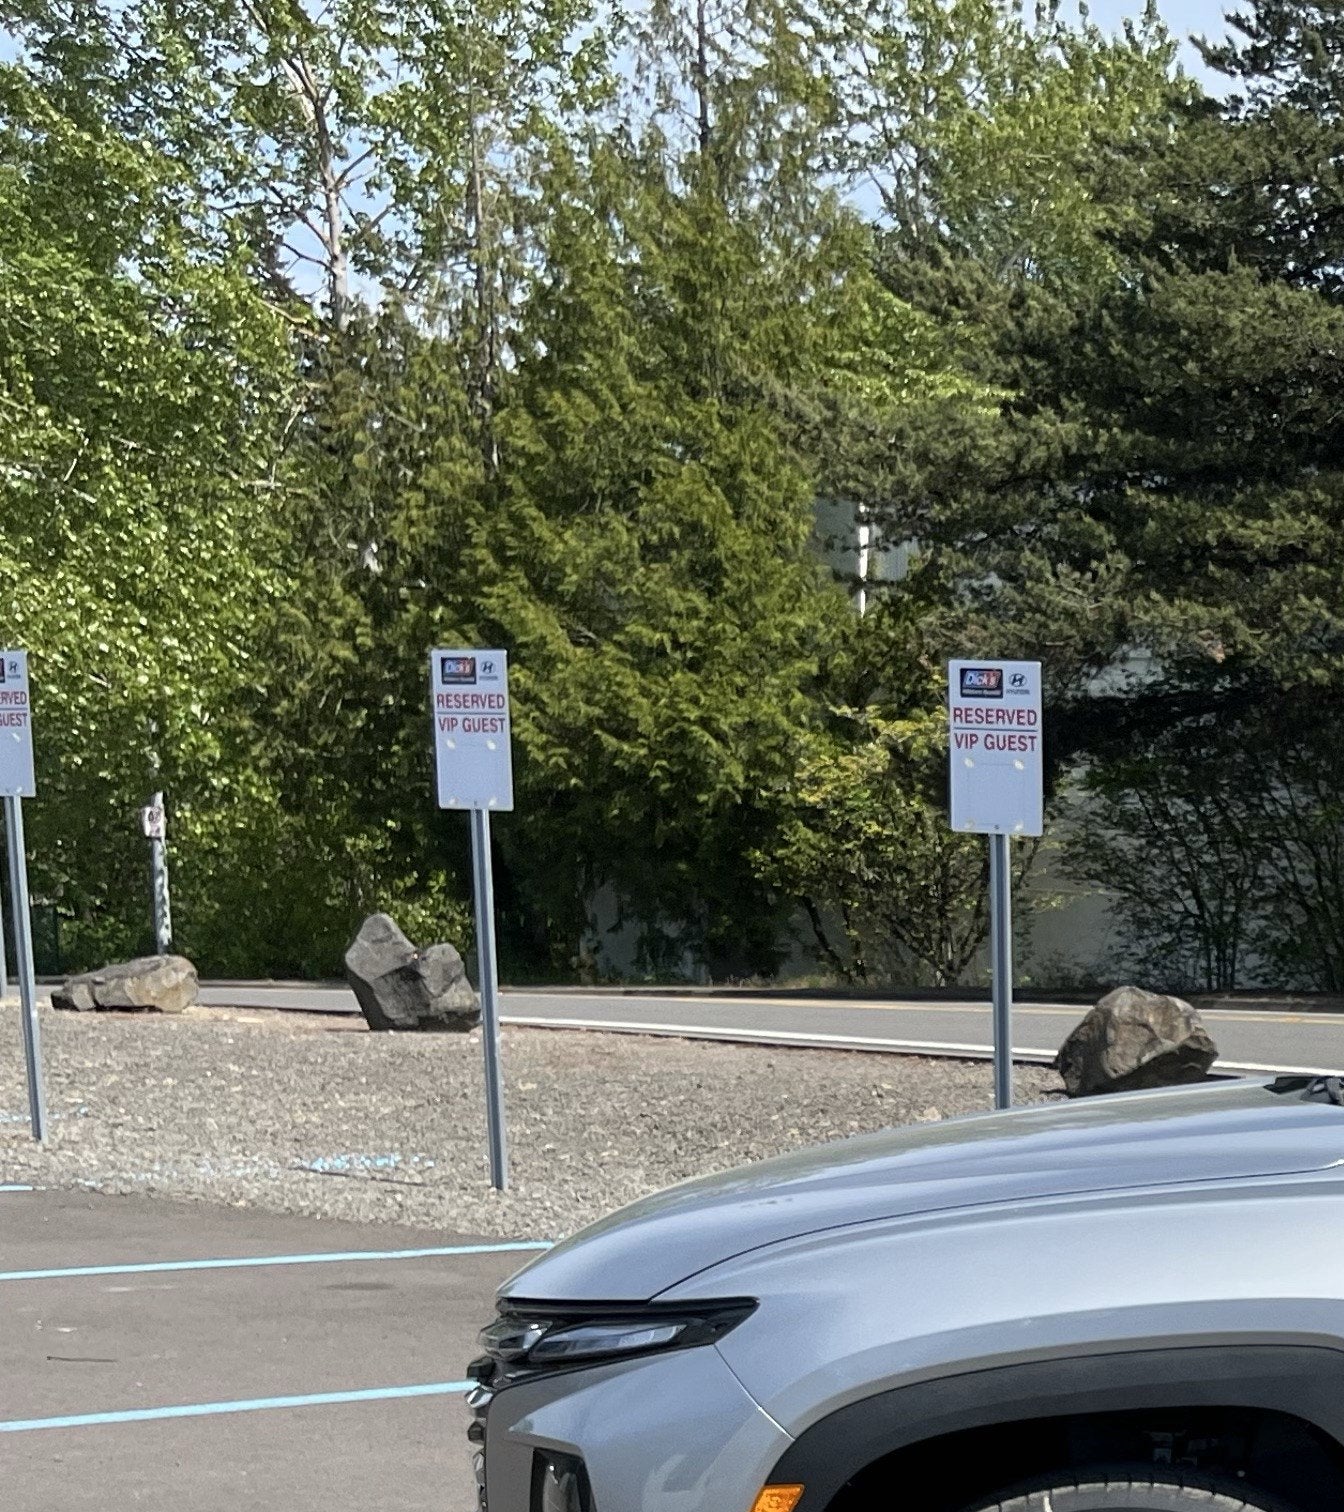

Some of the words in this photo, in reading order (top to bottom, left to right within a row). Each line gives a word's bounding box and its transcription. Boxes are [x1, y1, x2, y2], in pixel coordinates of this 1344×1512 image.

[436, 693, 506, 710] RESERVED
[438, 717, 459, 732] VIP
[462, 717, 506, 733] GUEST
[953, 706, 1037, 726] RESERVED
[954, 732, 979, 750] VIP
[983, 733, 1037, 752] GUEST
